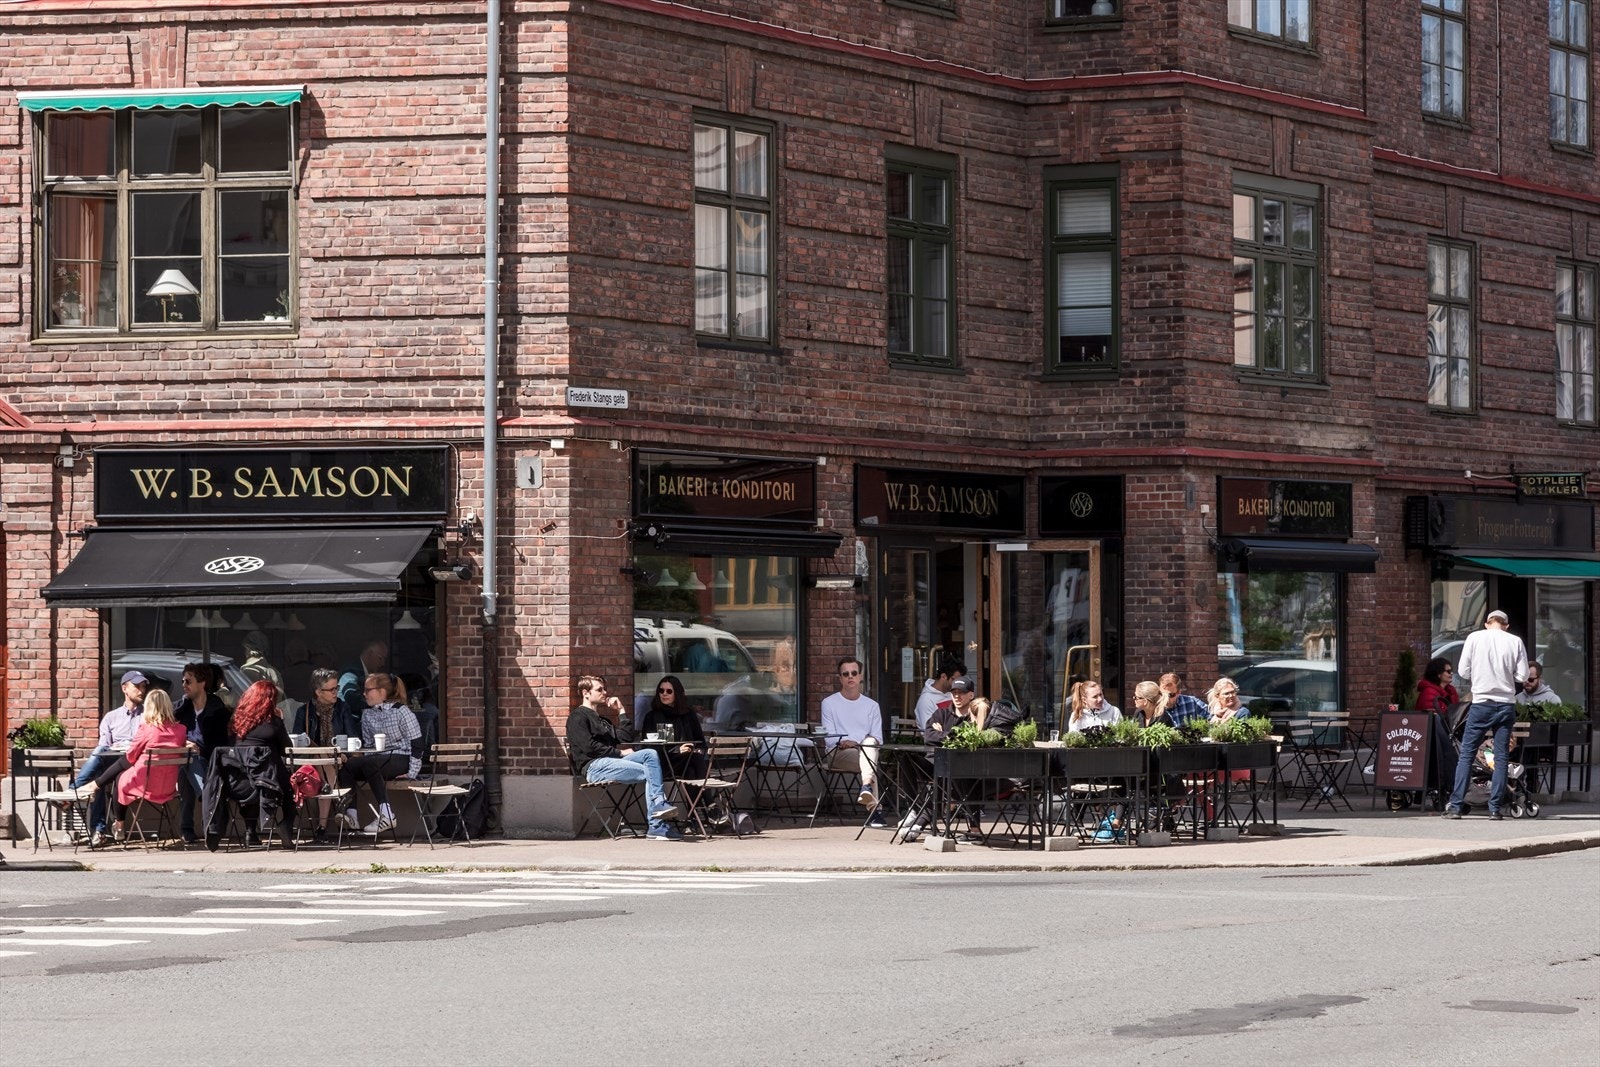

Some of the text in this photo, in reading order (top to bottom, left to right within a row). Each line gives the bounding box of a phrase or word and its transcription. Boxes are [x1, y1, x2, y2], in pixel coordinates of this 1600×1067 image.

[570, 390, 625, 406] Frederik Stangs gate
[130, 466, 413, 499] W. B. SAMSON
[659, 475, 795, 501] BAKERI & KONDITORI
[884, 482, 999, 516] W. B. SAMSON
[1238, 497, 1273, 516] BAKERI
[1284, 499, 1335, 518] KONDITORI
[1386, 728, 1422, 741] COLDBREW
[1392, 739, 1412, 753] Kaffe
